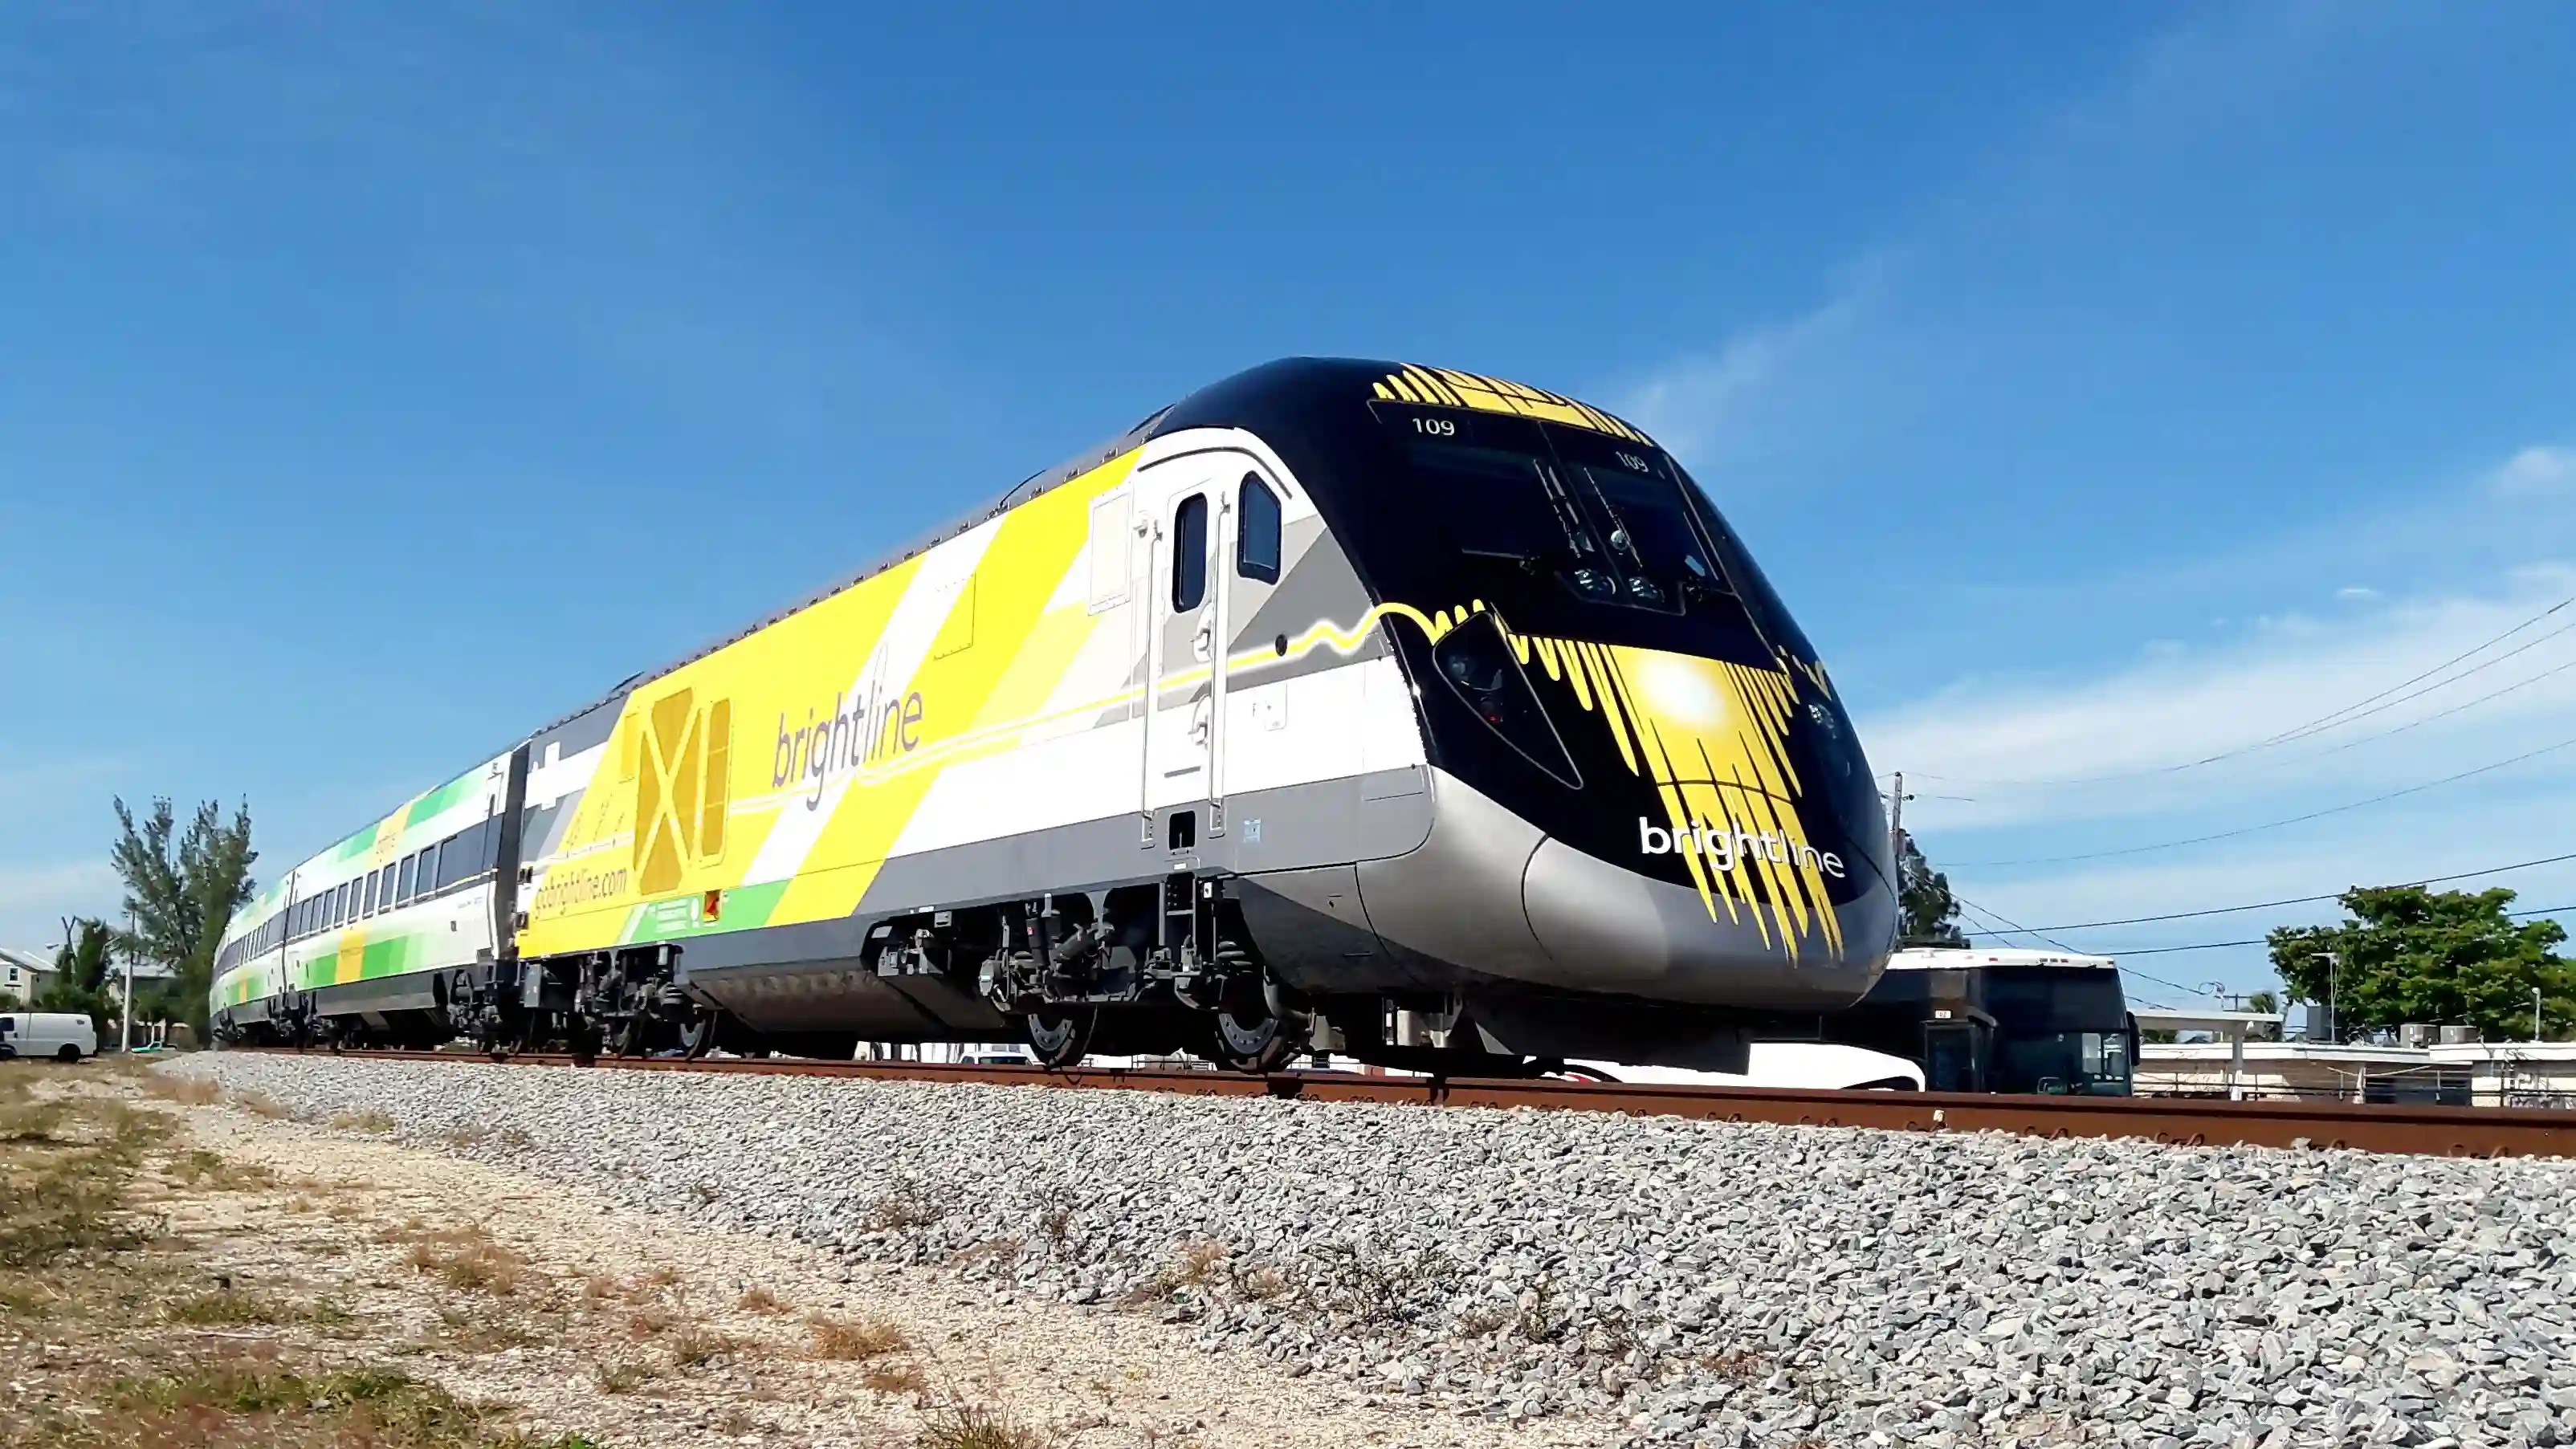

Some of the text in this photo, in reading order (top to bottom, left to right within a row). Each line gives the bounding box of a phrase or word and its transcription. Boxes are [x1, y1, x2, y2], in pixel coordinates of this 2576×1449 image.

[1412, 417, 1455, 436] 109
[1615, 450, 1649, 472] 109
[772, 679, 923, 812] brightline
[1639, 816, 1846, 878] brightline
